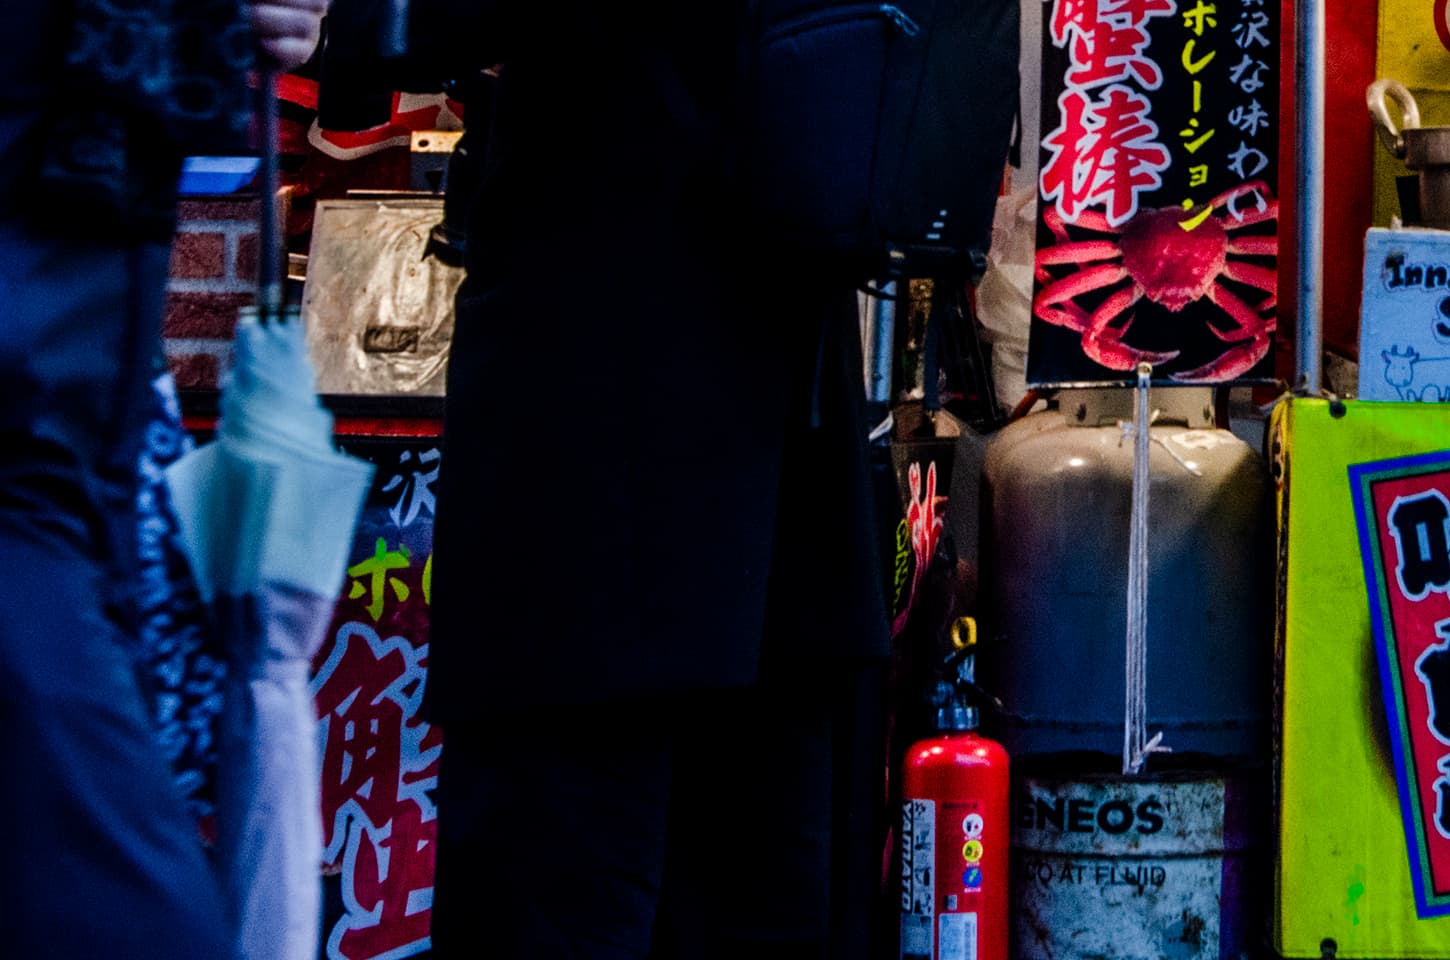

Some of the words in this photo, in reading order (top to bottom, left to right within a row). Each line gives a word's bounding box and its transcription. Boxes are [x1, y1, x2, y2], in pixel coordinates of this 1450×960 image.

[1016, 795, 1164, 835] ENEOS
[1060, 863, 1087, 885] AT
[1096, 864, 1167, 887] FLUID
